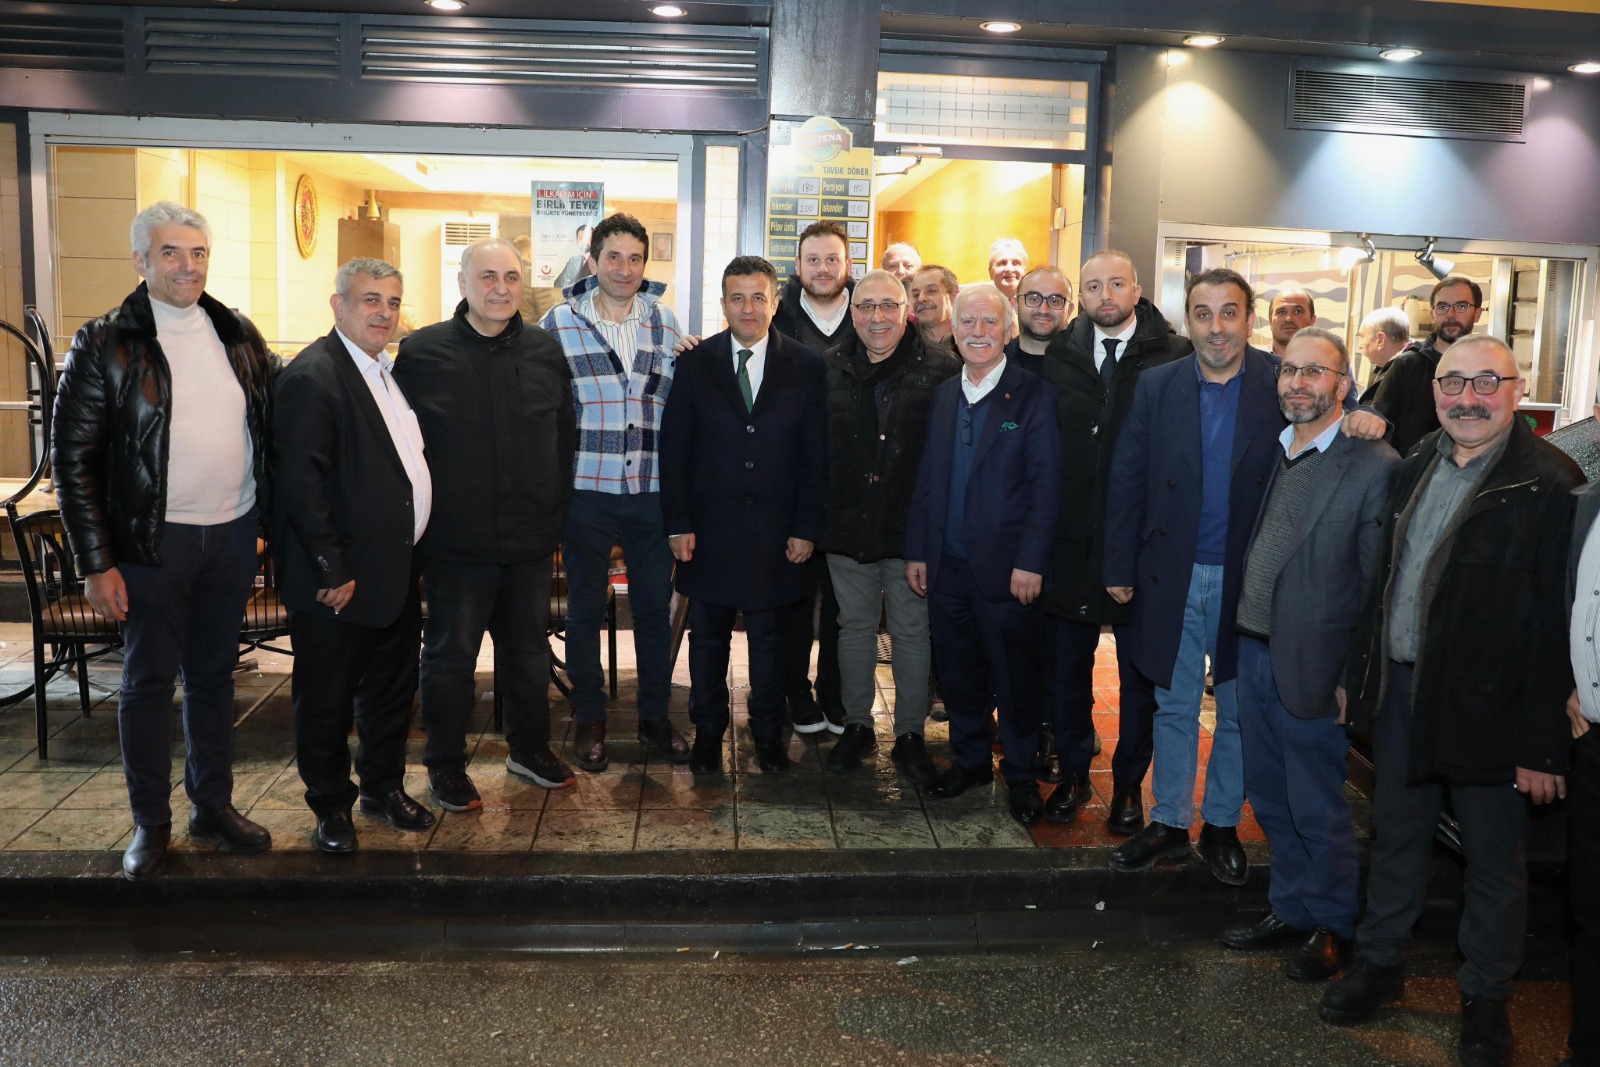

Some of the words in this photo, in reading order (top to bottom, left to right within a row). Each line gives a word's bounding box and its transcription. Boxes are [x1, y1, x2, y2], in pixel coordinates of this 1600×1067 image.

[823, 166, 844, 175] TAVUK
[847, 166, 869, 176] DÖNER
[822, 181, 845, 195] Porsiyon
